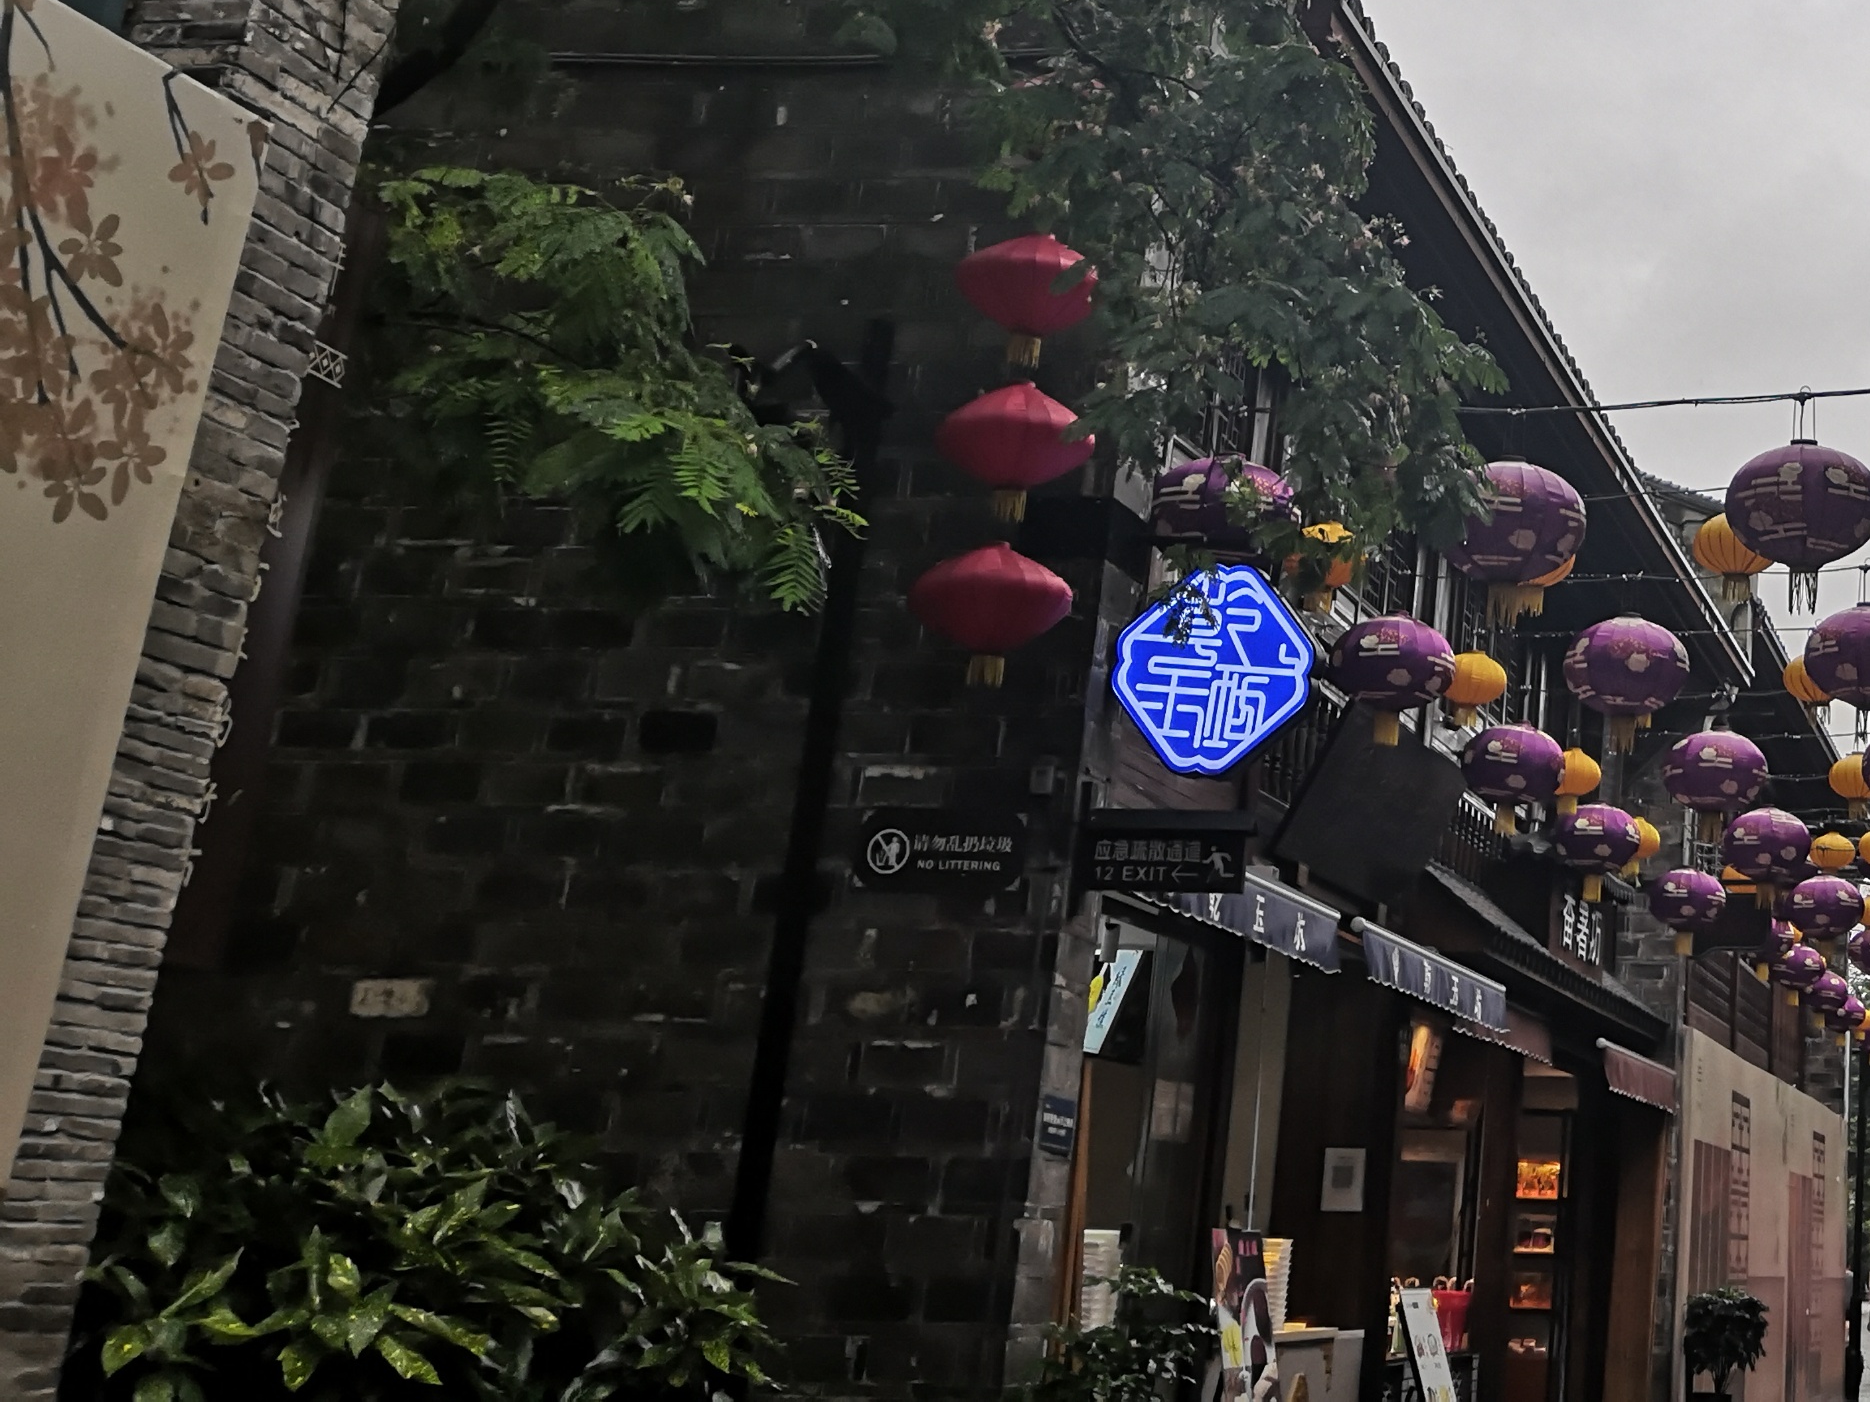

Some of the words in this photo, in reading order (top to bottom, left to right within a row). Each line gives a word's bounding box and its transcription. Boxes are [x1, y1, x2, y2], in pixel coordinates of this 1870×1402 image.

[913, 834, 1013, 853] 请勿乱扔垃圾
[1094, 839, 1202, 863] 应急疏散通道
[917, 859, 935, 870] NO
[938, 859, 1001, 871] LITTERING
[1094, 866, 1114, 881] 12
[1122, 865, 1168, 882] EXIT
